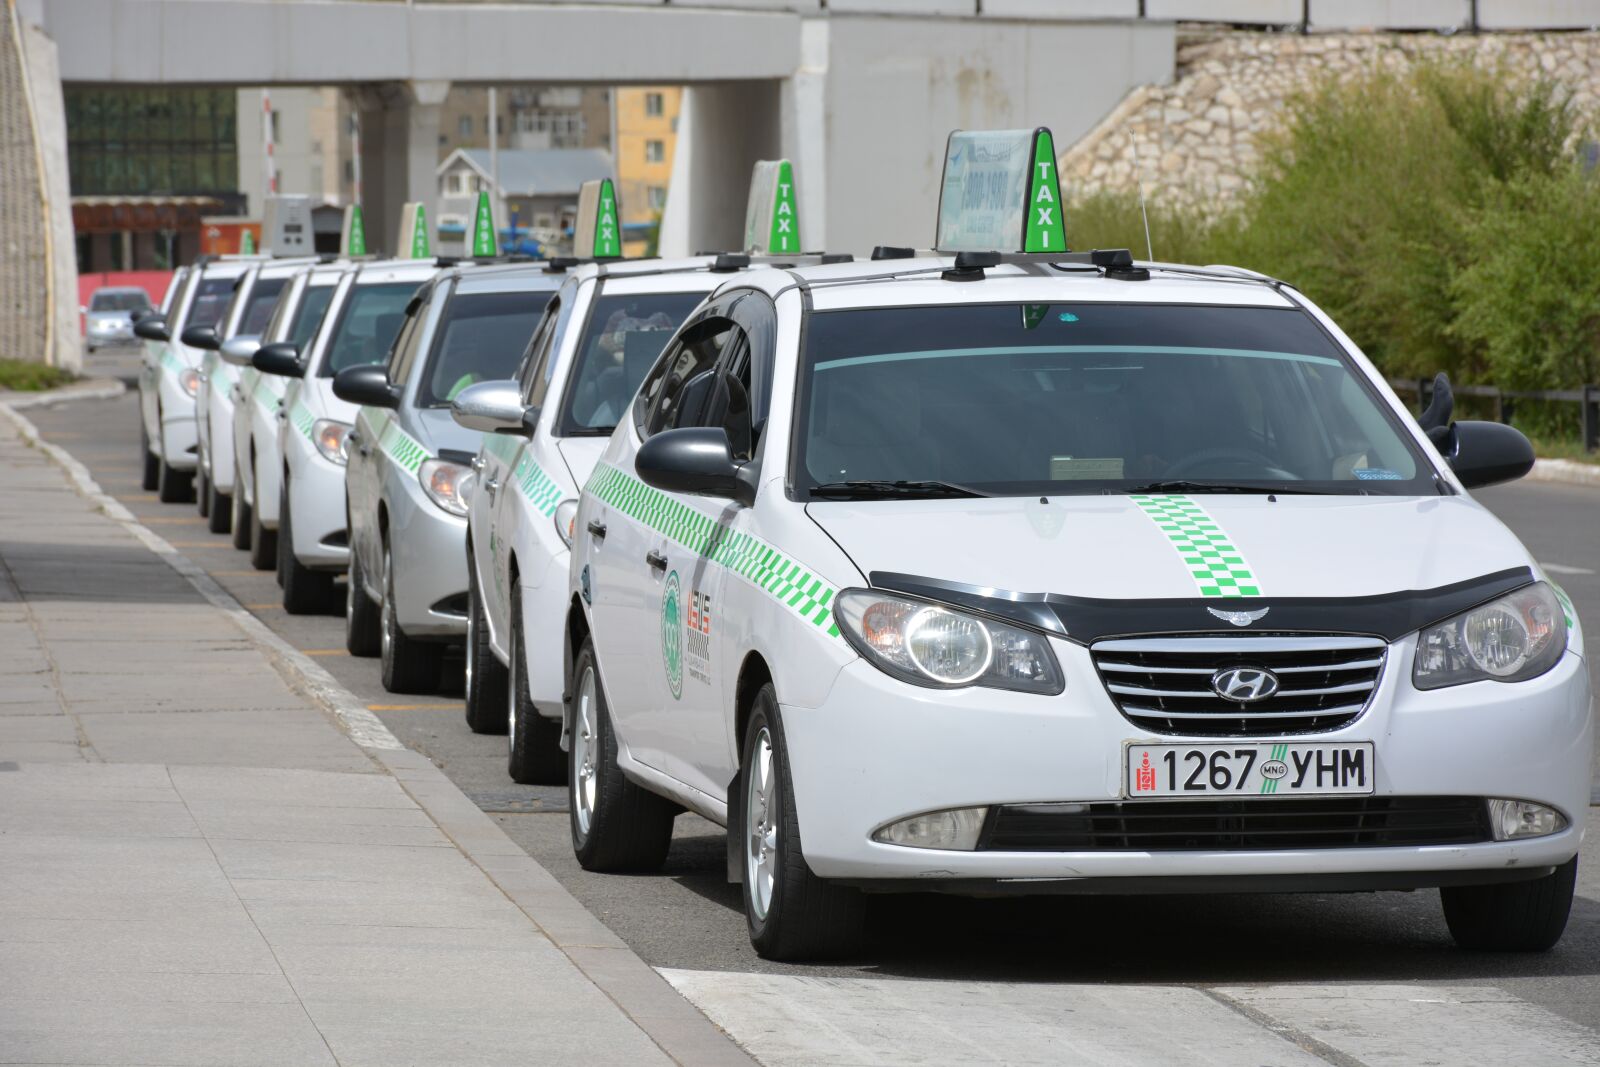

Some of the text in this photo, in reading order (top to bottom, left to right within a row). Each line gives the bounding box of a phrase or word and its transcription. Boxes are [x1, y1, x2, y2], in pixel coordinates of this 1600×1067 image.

[479, 207, 489, 254] 1991
[601, 198, 613, 254] TAXI
[777, 184, 791, 250] TAXI
[1036, 162, 1054, 248] TAXI
[415, 215, 425, 256] TAXI
[1163, 749, 1365, 791] 1267 MNG УНМ
